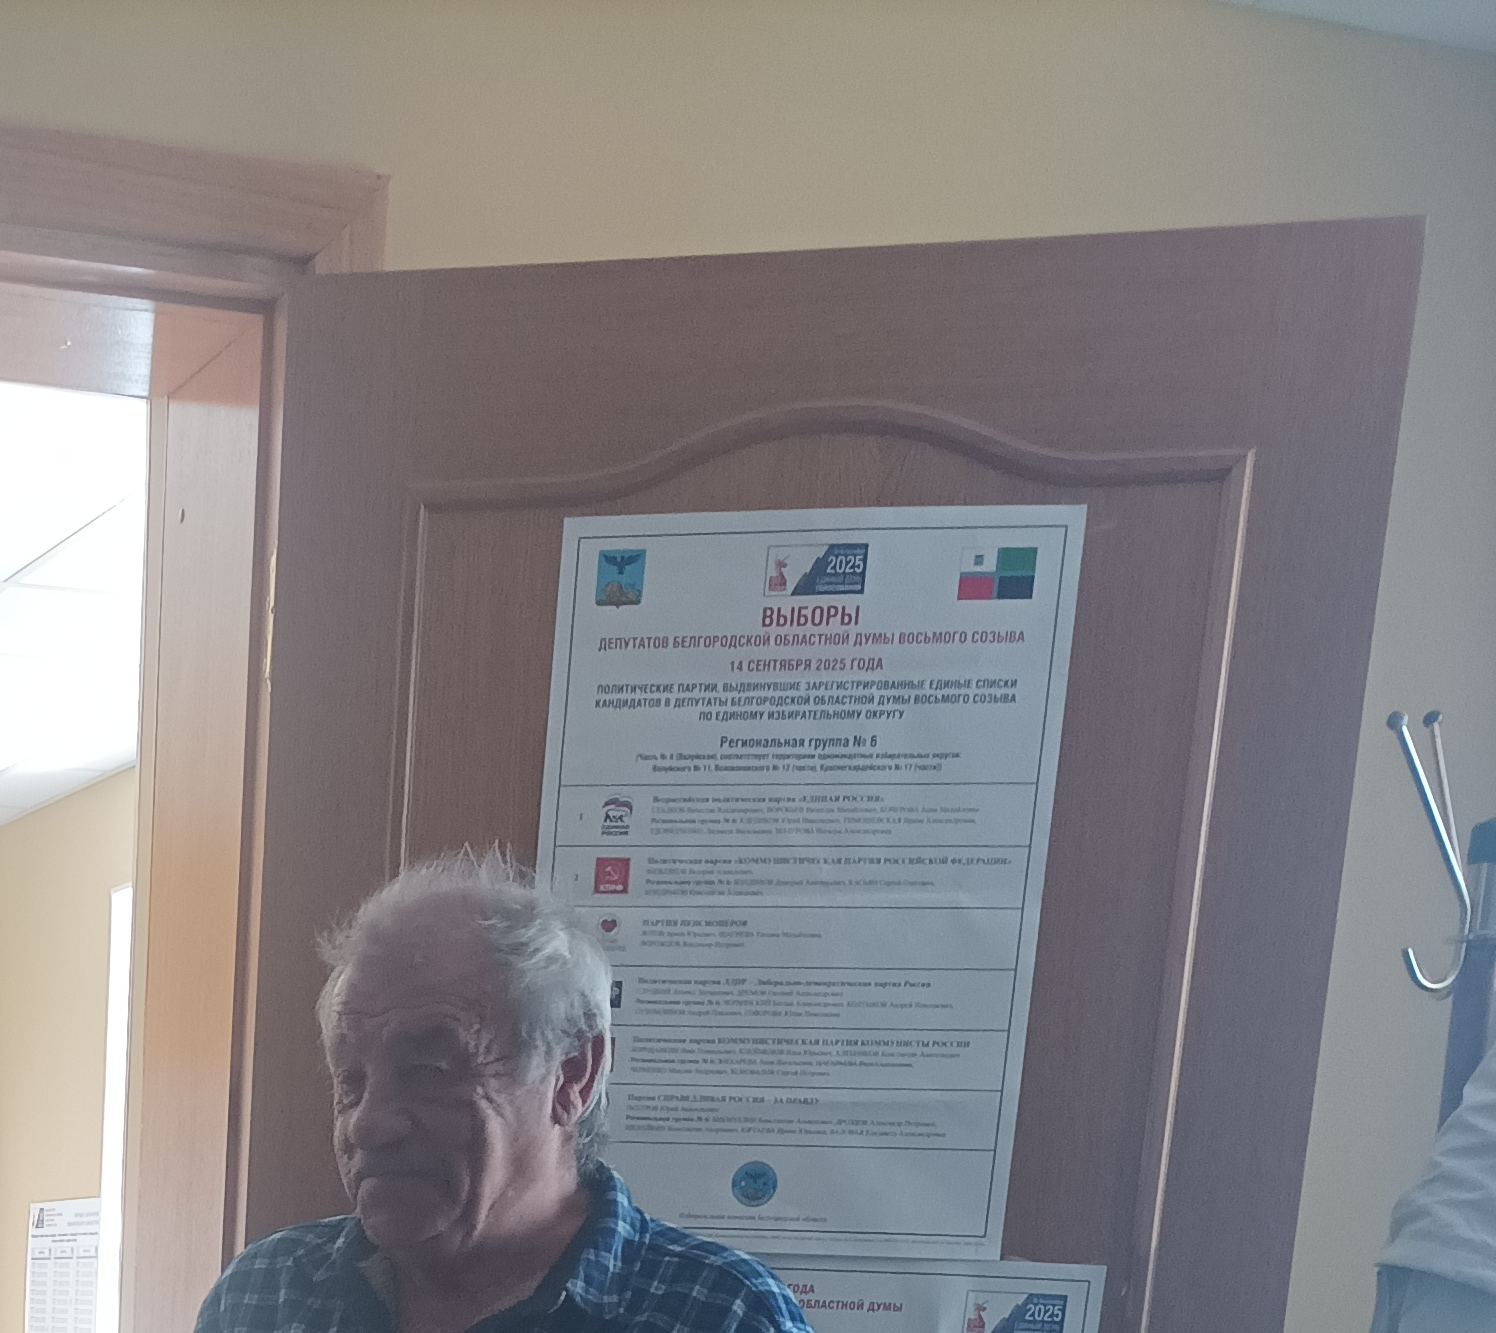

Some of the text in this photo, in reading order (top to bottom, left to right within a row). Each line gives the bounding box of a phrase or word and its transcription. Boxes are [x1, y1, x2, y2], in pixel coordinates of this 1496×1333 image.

[826, 555, 864, 574] 2025
[761, 605, 861, 628] ВЫБОРЫ
[598, 630, 1025, 652] ДЕПУТАТОВ БЕЛГОРОДСКОЙ ОБЛАСТНОЙ ДУМЫ ВОСЬМОГО СОЗЫВА
[729, 657, 884, 673] 14 СЕНТЯБРЯ 2025 ГОДА
[596, 683, 675, 695] ПОЛИТИЧЕСКИЕ
[722, 681, 802, 694] ВЫДВИНУВШИЕ
[805, 680, 926, 692] ЗАРЕГИСТРИРОВАННЫЕ
[929, 679, 973, 691] ЕДИНЫЕ
[975, 678, 1018, 690] СПИСКИ
[595, 692, 1017, 710] КАНДИДАТОВ В ДЕПУТАТЫ БЕЛГОРОДСКОЙ ОБЛАСТНОЙ ДУМЫ ВОСЬМОГО СОЗЫВА
[698, 708, 905, 722] ПО ЕДИНОМУ ИЗБИРАТЕЛЬНОМУ ОКРУГУ
[719, 735, 878, 751] Региональная группа № 6
[799, 1299, 904, 1313] ОБЛАСТНОЙ ДУМЫ
[1025, 1304, 1063, 1322] 2025
